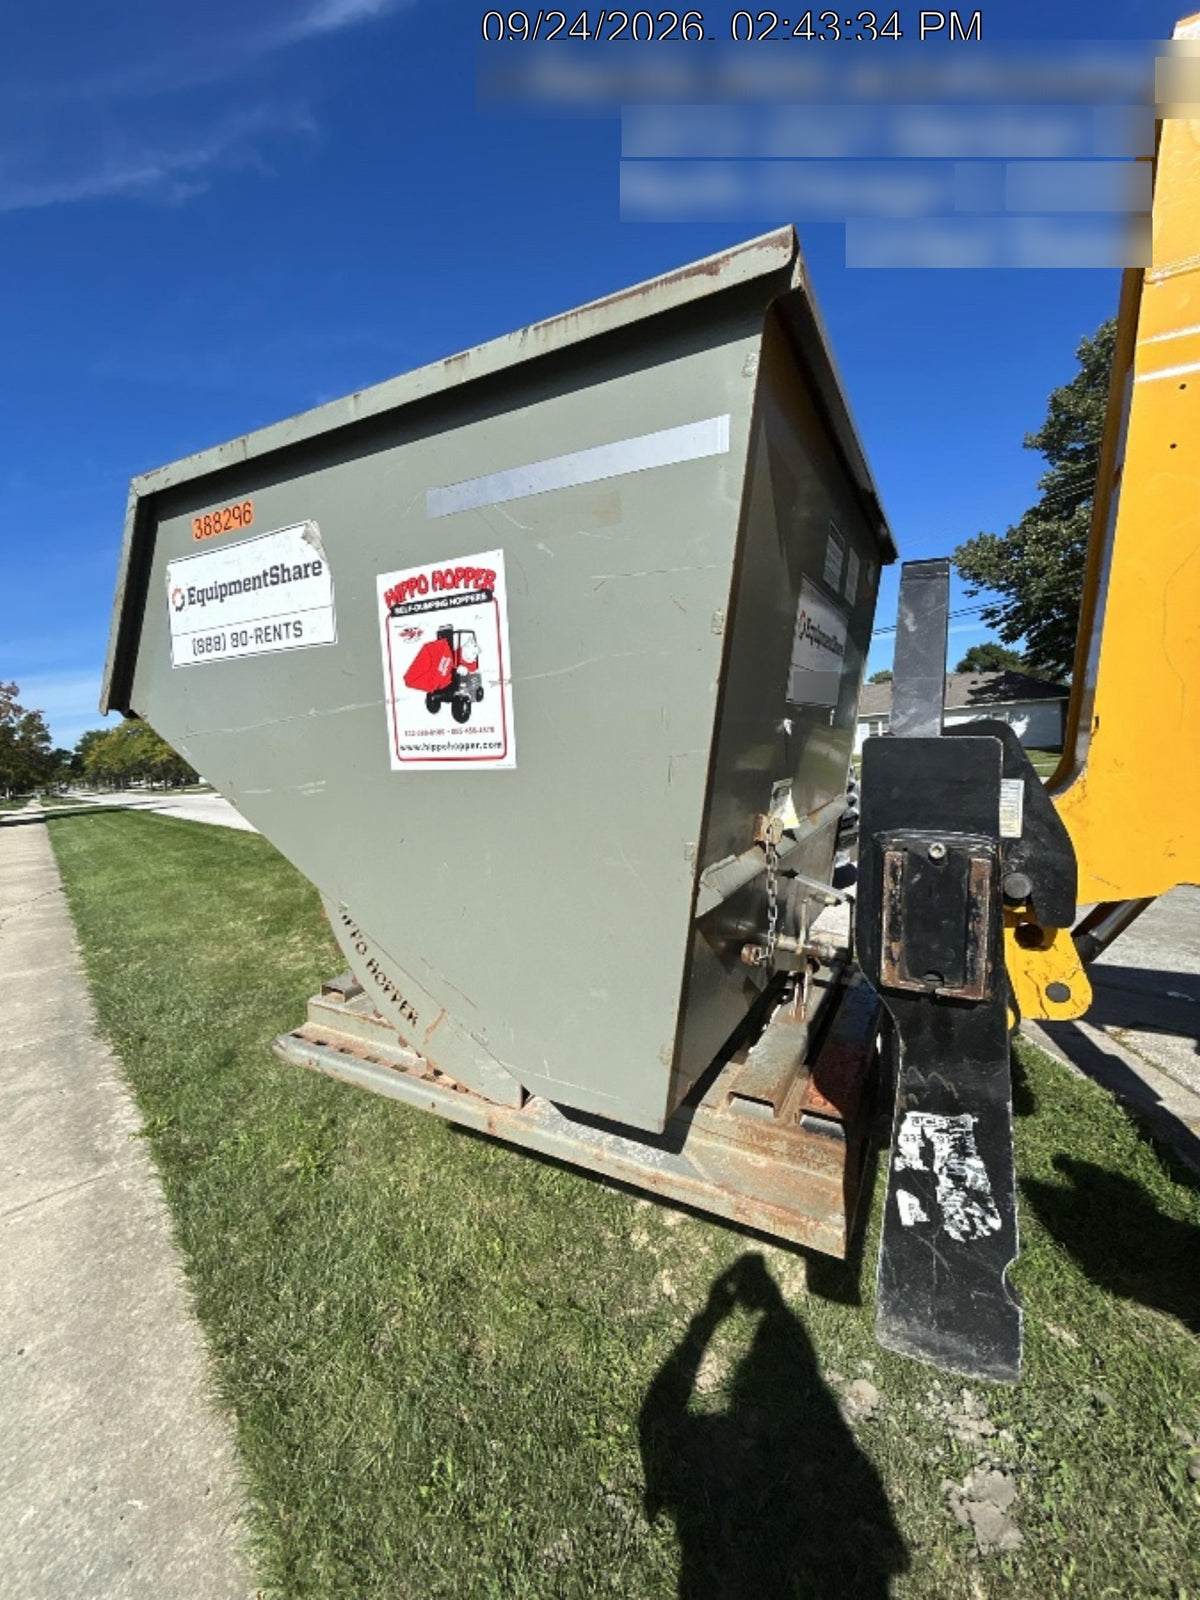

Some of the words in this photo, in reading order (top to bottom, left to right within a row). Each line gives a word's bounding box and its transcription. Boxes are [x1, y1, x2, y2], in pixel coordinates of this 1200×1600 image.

[194, 502, 252, 539] 388296
[187, 560, 322, 607] EquipmentShare
[384, 574, 428, 609] HIPPO
[432, 567, 496, 592] HOPPER
[230, 620, 303, 649] 80-RENTS
